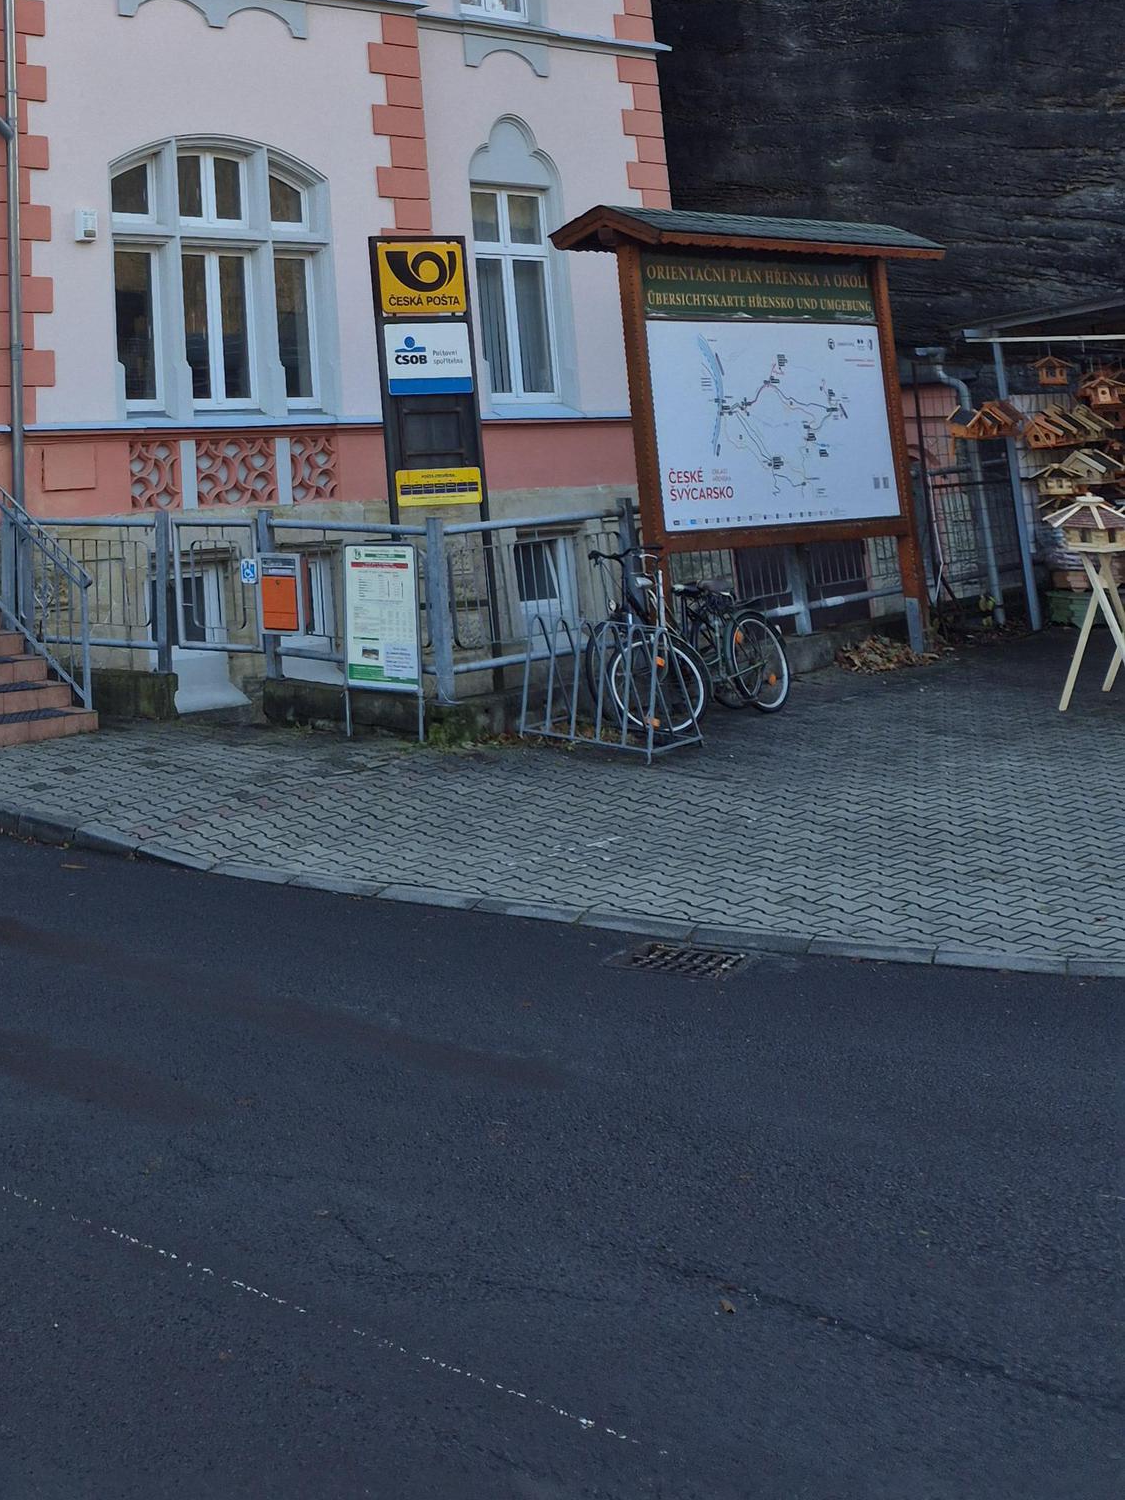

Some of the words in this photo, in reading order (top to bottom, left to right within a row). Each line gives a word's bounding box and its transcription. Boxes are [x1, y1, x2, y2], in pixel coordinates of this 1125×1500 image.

[646, 264, 726, 282] ORIENTAČNÍ
[730, 267, 762, 284] PLÁN
[765, 268, 820, 286] HŘENSKA
[823, 274, 831, 287] A
[834, 273, 868, 289] OKOLÍ
[388, 294, 423, 306] ČESKÁ
[426, 294, 460, 306] POŠTA
[647, 289, 747, 308] ÜBERSICHTSKARTE
[748, 293, 794, 309] HŘENSKO
[796, 298, 817, 309] UND
[820, 299, 872, 312] UMGEBUNG
[395, 354, 428, 365] ČSOB
[668, 466, 704, 484] ČESKÉ
[670, 484, 734, 502] ŠVÝCARSKO
